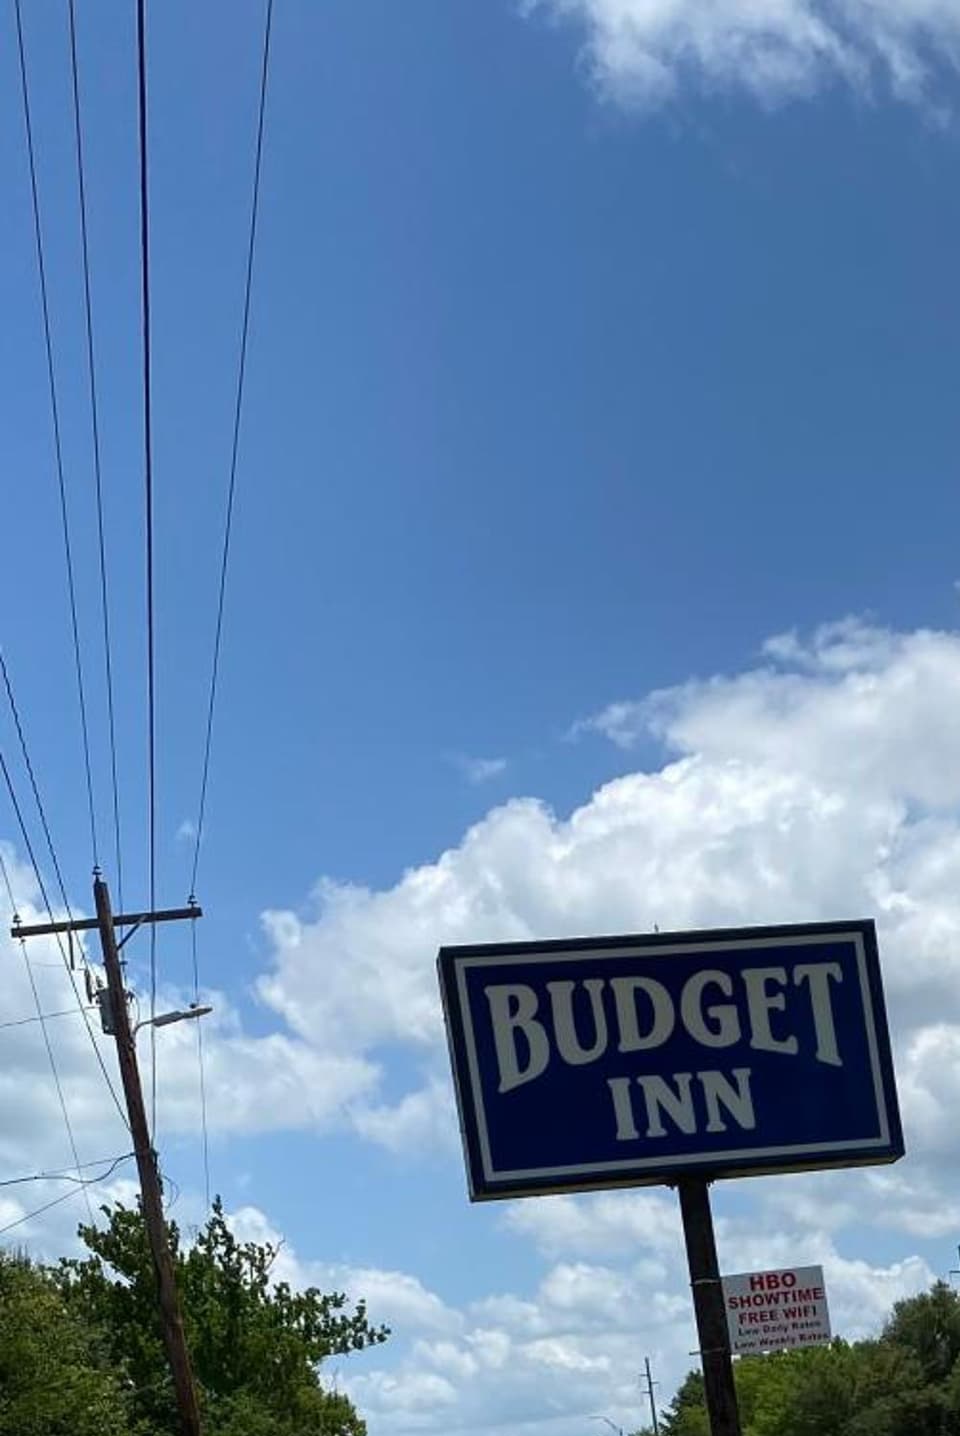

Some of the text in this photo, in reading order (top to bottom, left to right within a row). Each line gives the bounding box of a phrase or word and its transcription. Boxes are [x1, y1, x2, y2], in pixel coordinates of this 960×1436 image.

[484, 961, 844, 1094] BUDGET
[607, 1067, 756, 1141] INN
[749, 1272, 796, 1291] HBO
[728, 1287, 825, 1309] SHOWTIME
[738, 1305, 817, 1325] FREE WIFI
[738, 1320, 820, 1336] Low Daily Rates
[735, 1333, 830, 1349] Low Weekly Rates
